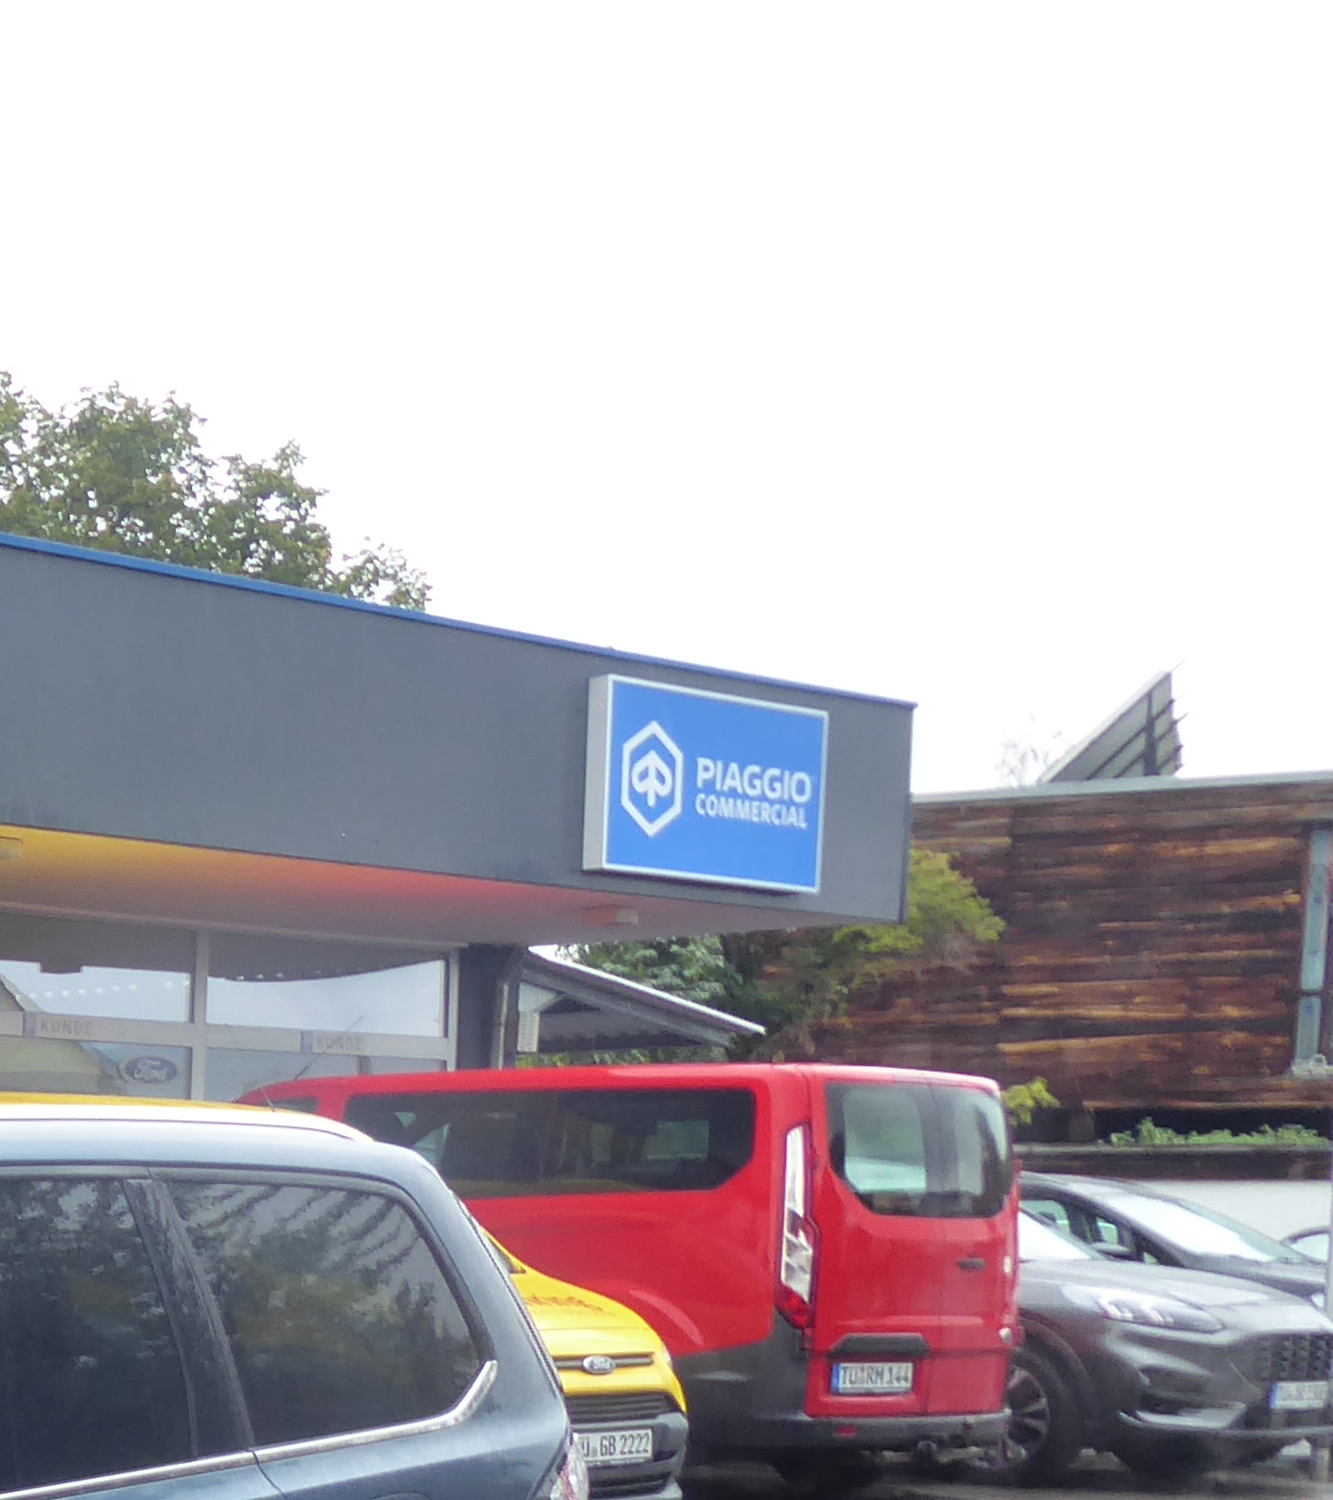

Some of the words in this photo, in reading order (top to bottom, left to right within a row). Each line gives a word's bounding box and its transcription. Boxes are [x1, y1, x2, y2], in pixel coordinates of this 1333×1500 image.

[696, 757, 812, 803] PIAGGIO
[696, 793, 807, 829] COMMERCIAL
[599, 1434, 617, 1457] GB
[620, 1432, 650, 1455] 2222
